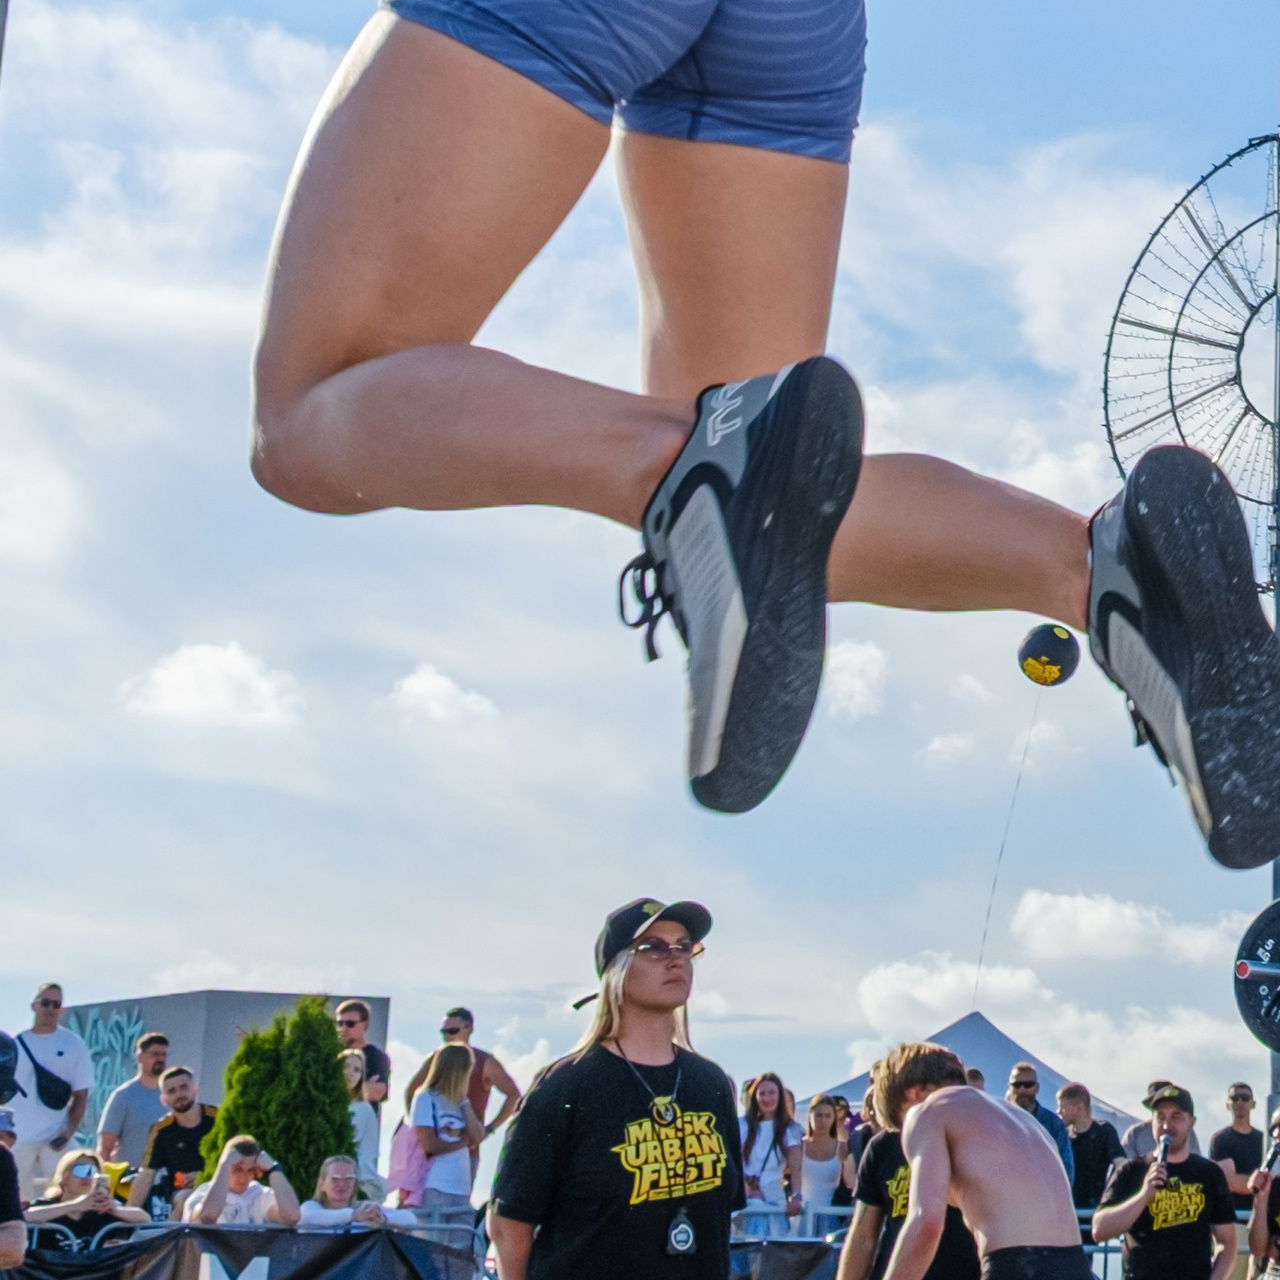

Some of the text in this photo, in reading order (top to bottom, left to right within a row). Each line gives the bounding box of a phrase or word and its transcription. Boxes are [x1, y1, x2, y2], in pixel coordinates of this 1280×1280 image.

[624, 1133, 721, 1168] URBAN
[638, 1153, 719, 1196] FEST
[1152, 1193, 1202, 1214] URBAN
[1158, 1205, 1198, 1225] FEST
